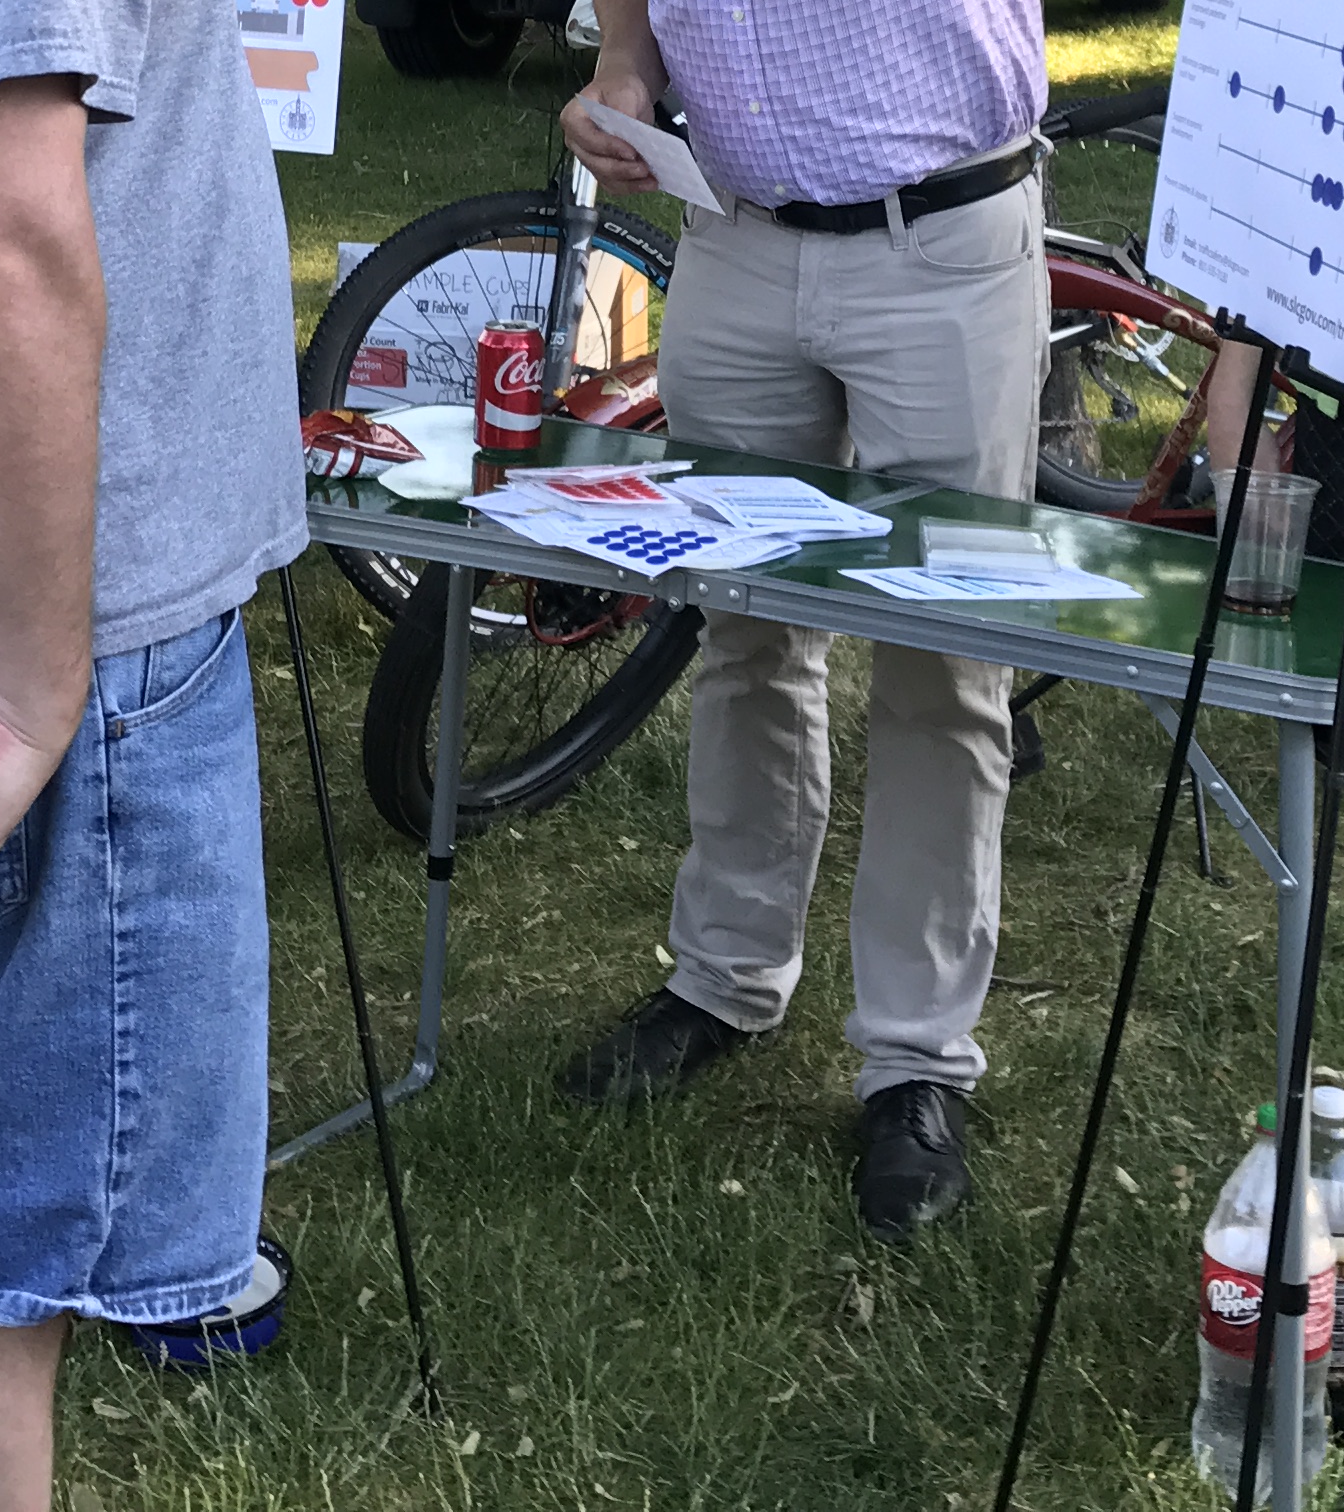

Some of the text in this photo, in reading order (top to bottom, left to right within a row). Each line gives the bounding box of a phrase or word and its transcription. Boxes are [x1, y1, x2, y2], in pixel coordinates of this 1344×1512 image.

[370, 336, 396, 347] Count
[349, 370, 371, 382] Cups
[1223, 1280, 1248, 1299] Dr
[1206, 1278, 1263, 1317] Pepper
